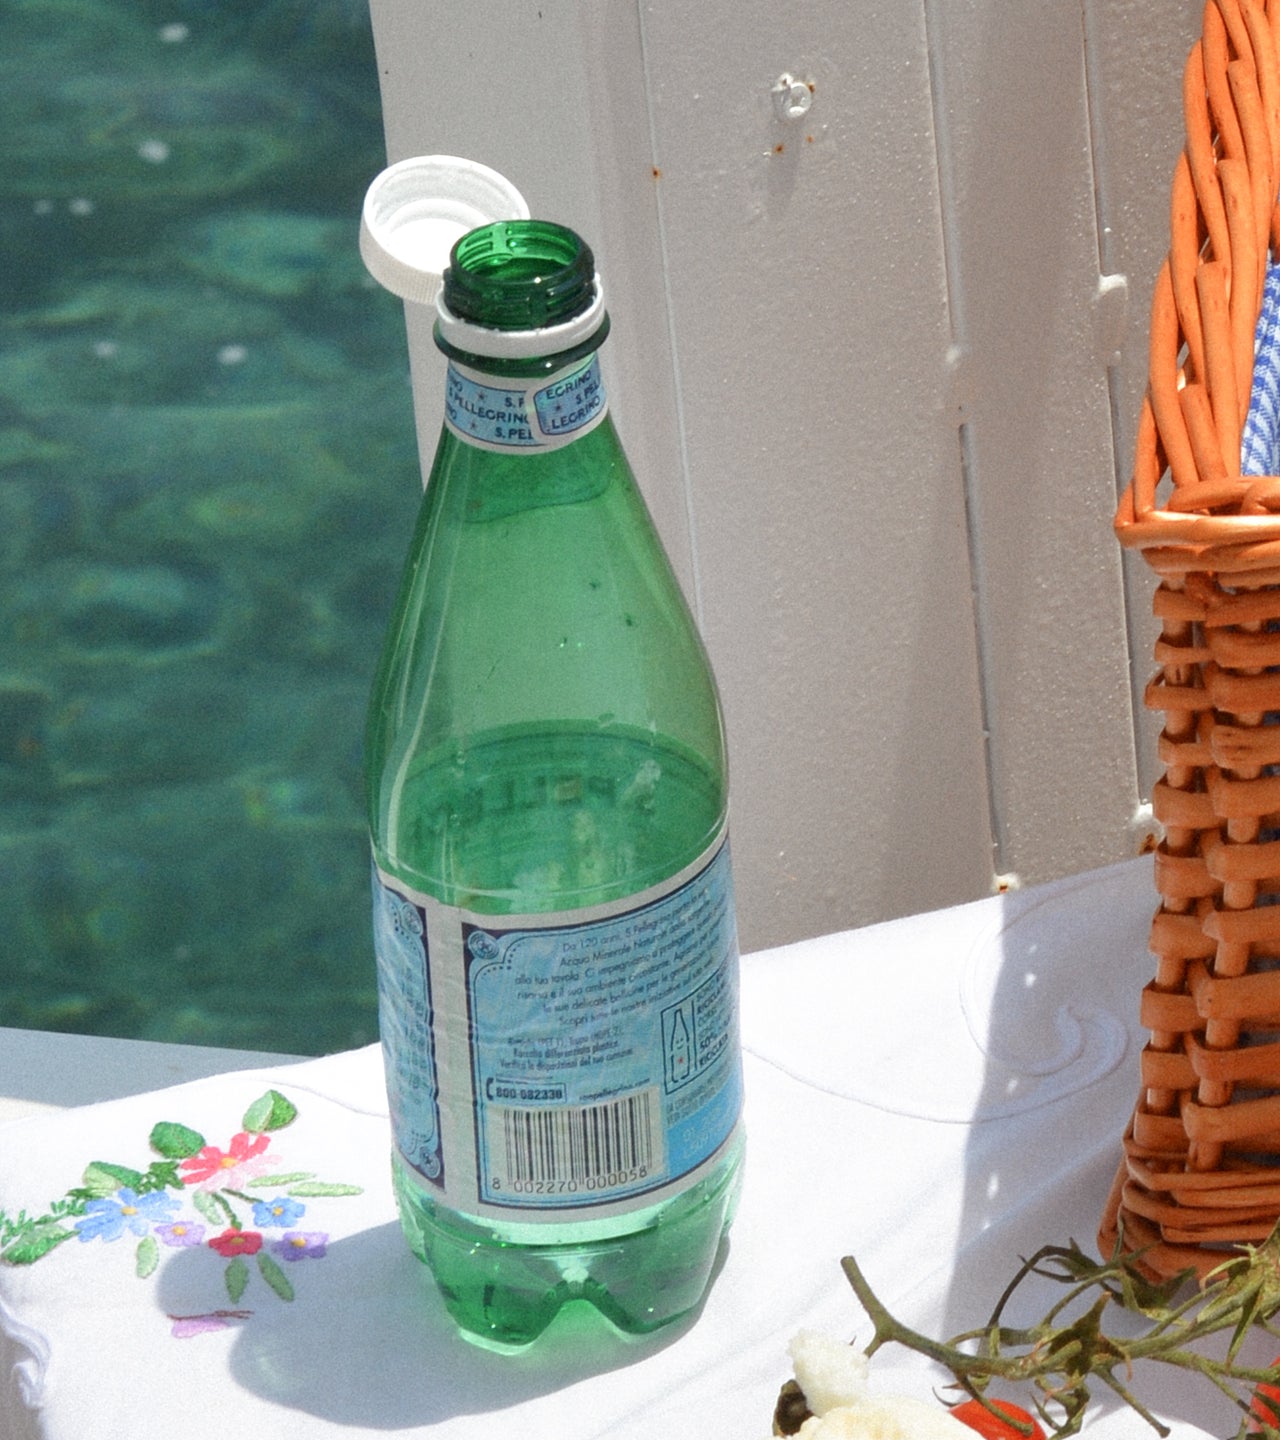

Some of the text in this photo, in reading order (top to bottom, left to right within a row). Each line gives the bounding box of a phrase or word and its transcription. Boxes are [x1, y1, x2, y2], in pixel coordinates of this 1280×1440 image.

[560, 956, 590, 968] Acqua
[592, 942, 631, 961] Minerale
[492, 1165, 648, 1194] 8 002270 000058
